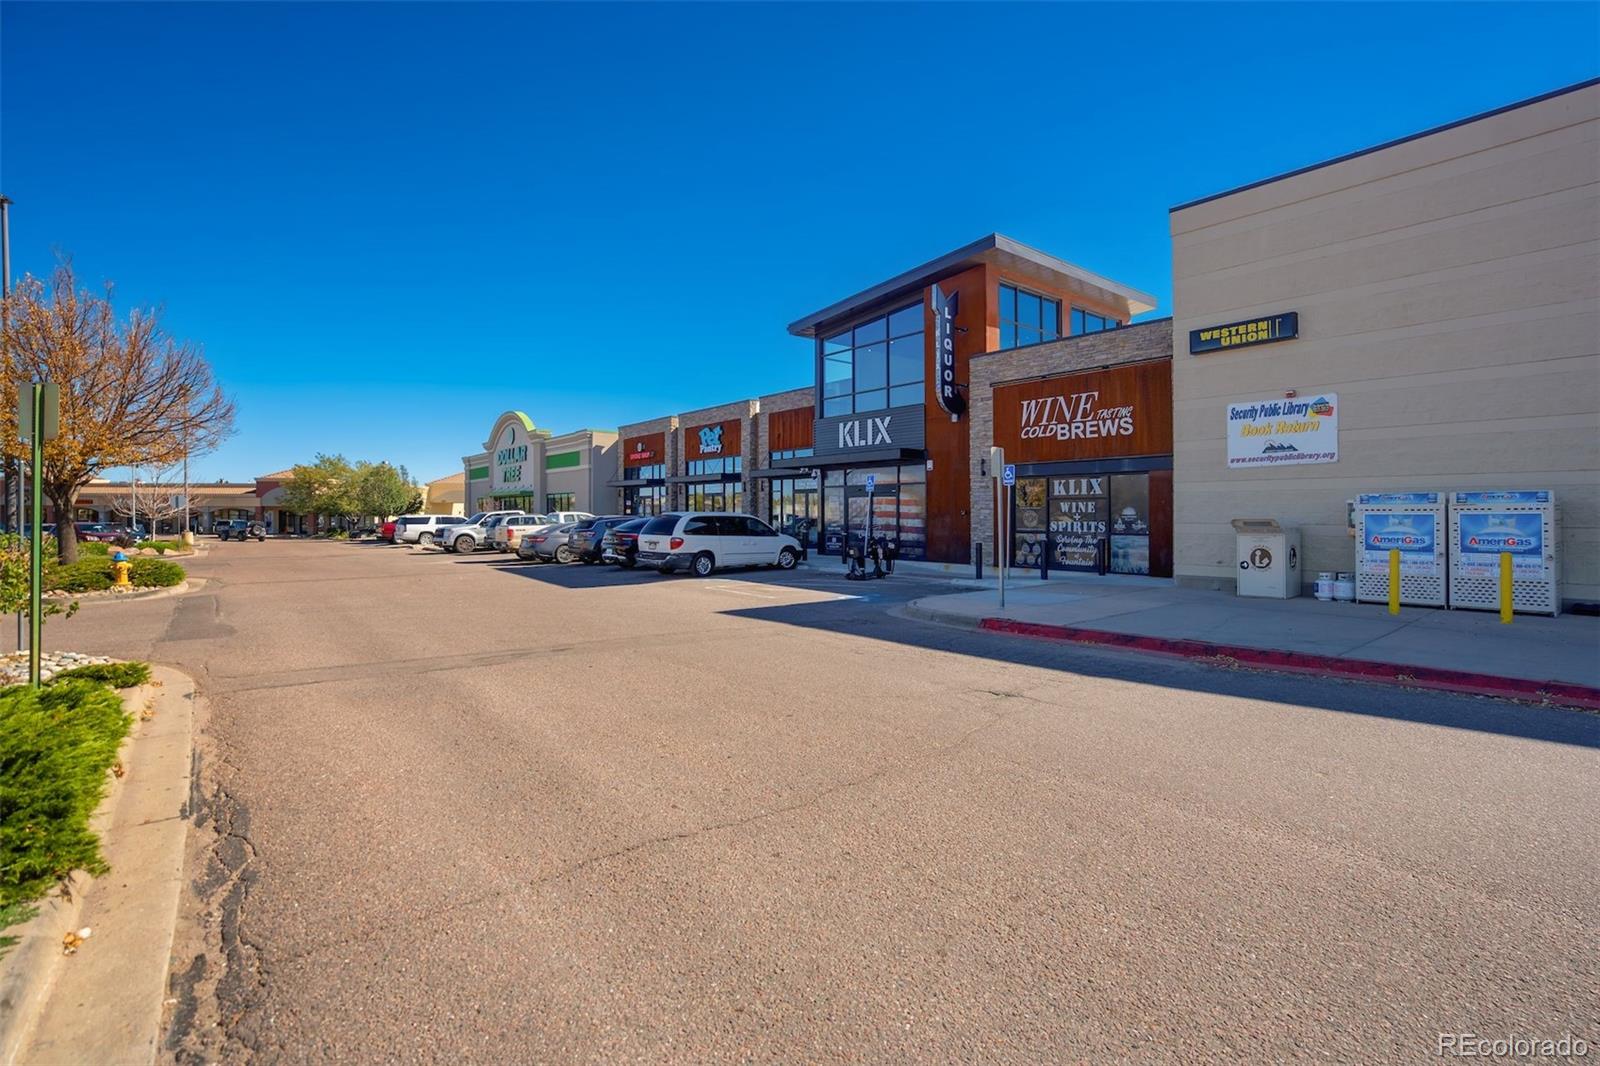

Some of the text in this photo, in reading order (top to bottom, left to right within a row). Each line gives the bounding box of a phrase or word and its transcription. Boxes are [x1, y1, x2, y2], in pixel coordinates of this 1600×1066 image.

[1200, 320, 1268, 341] WESTERN
[1221, 330, 1268, 346] UNION
[944, 306, 953, 398] LIQUOR
[1020, 391, 1099, 427] WINE
[1096, 405, 1134, 420] TASTING
[1230, 401, 1310, 422] Security Public Library
[838, 416, 893, 448] KLIX
[1020, 417, 1134, 441] COLD BREWS
[1276, 420, 1320, 434] Return
[698, 425, 723, 447] Pet
[699, 443, 722, 454] Pantry
[1053, 478, 1103, 496] KLIX
[1060, 501, 1096, 513] WINE
[1050, 521, 1106, 534] SPIRITS
[1372, 536, 1426, 545] AmeriGas
[1469, 537, 1532, 546] AmeriGas
